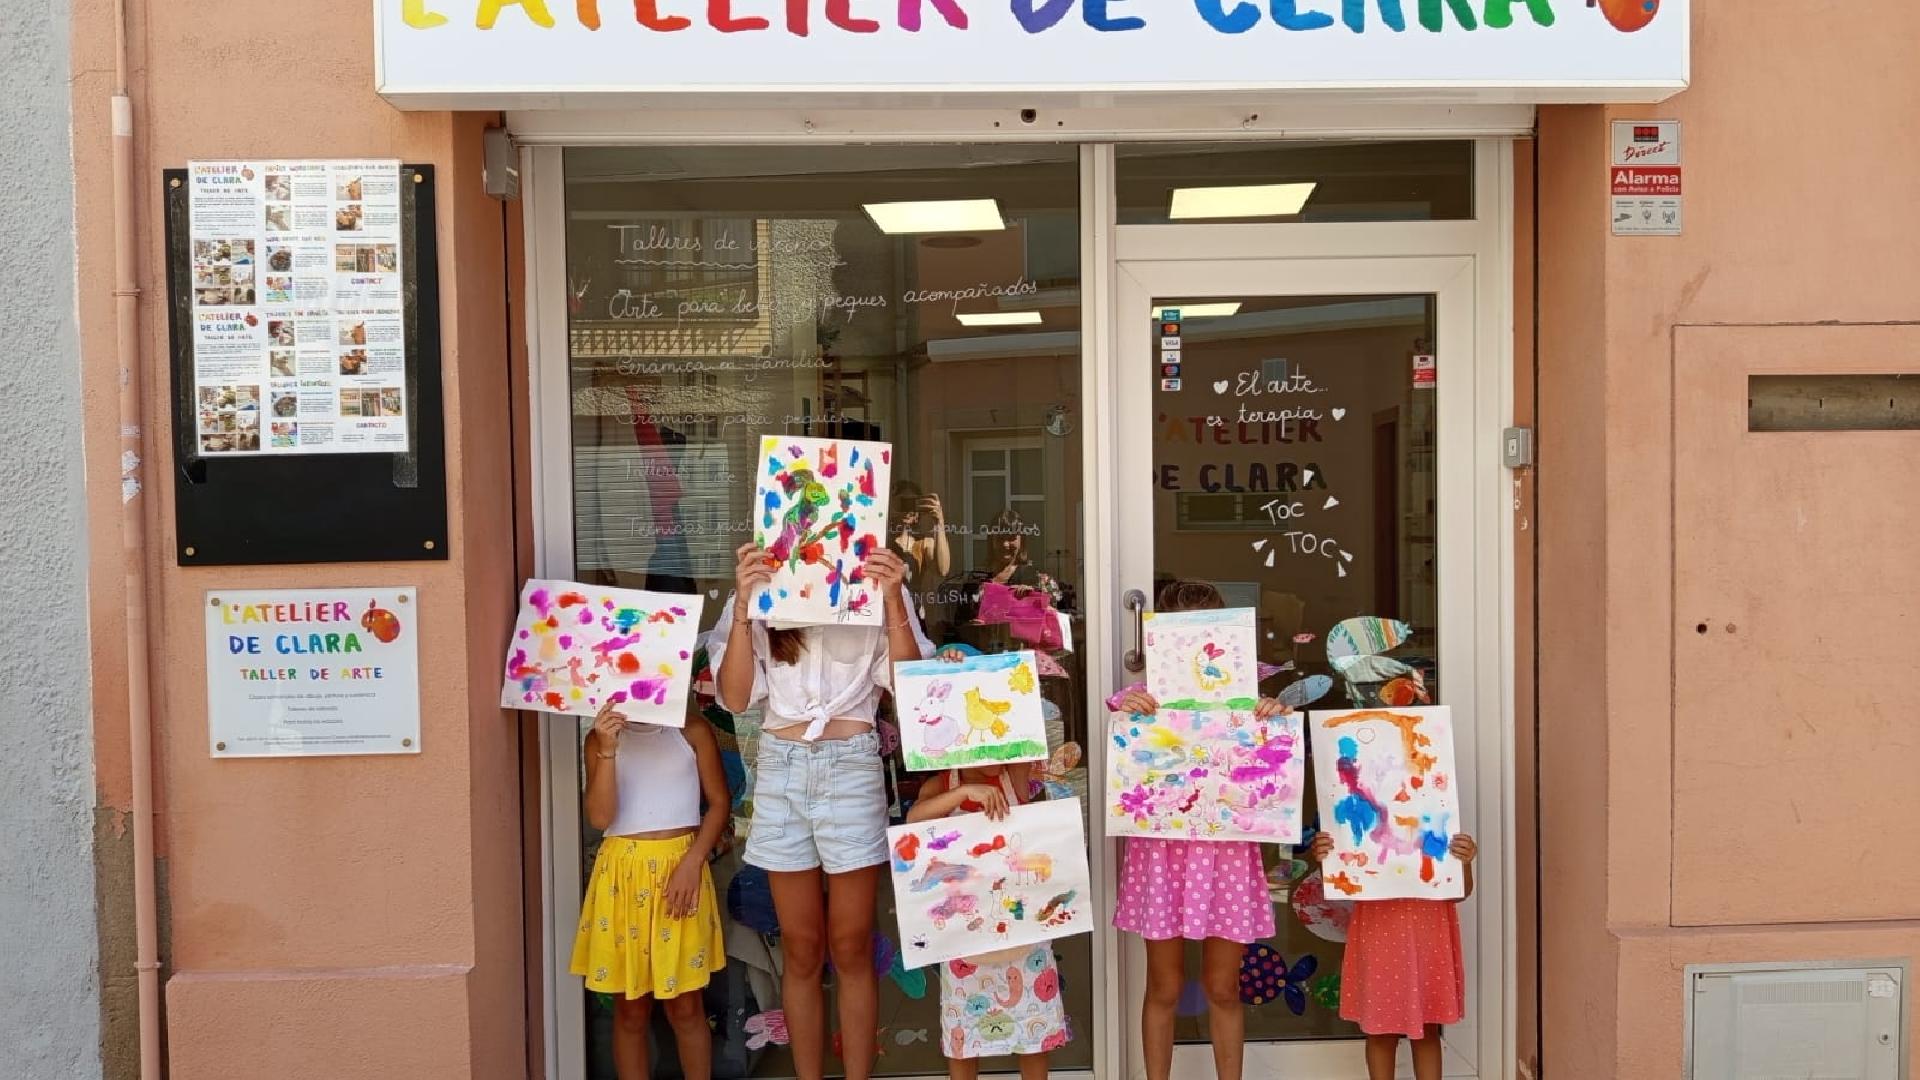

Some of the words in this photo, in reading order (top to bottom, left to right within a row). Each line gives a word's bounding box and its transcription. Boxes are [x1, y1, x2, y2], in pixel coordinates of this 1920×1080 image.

[1614, 170, 1679, 184] Alarma
[607, 225, 701, 253] Talleres
[714, 229, 740, 250] de
[608, 290, 662, 320] Arte
[678, 299, 725, 329] para
[821, 294, 887, 325] peques
[903, 276, 1037, 317] acompañados
[1235, 368, 1262, 396] El
[1207, 415, 1223, 427] es
[1238, 402, 1323, 438] terapia
[1200, 462, 1328, 493] CLARA
[980, 521, 1041, 536] adultos
[1284, 531, 1336, 557] TOC
[229, 634, 261, 655] DE
[276, 633, 362, 655] CLARA
[240, 668, 297, 680] TALLER
[310, 668, 329, 680] DE
[341, 667, 384, 680] ARTE
